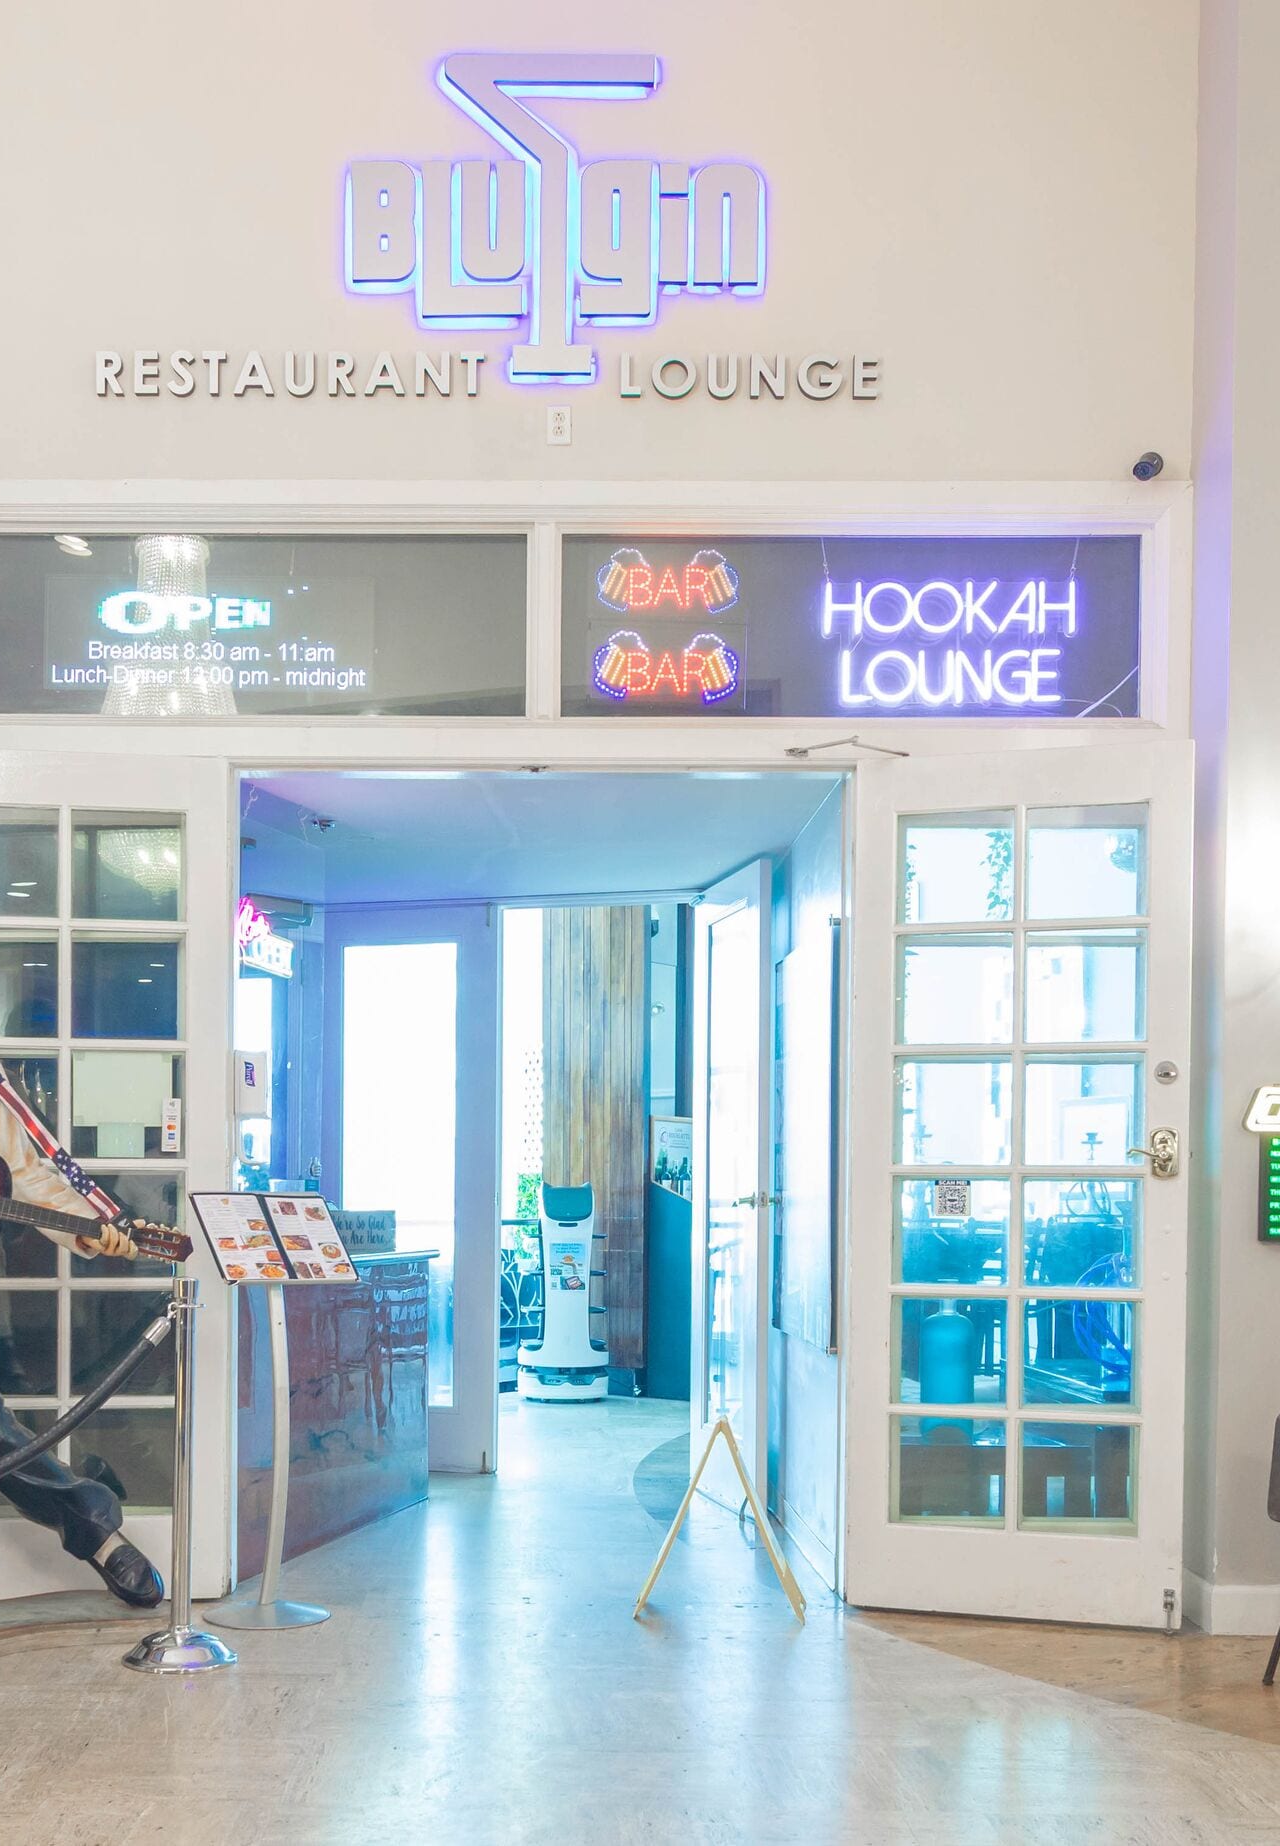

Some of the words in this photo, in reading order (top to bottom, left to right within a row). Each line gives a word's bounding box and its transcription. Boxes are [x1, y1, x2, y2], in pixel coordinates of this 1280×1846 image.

[95, 350, 486, 399] RESTAURANT
[619, 352, 881, 401] LOUNGE
[629, 567, 710, 607] BAR
[822, 579, 1077, 636] HOOKAH
[88, 640, 179, 660] Breakfast
[183, 642, 225, 661] 8:30
[229, 645, 260, 661] am
[238, 669, 269, 689] pm
[285, 668, 367, 690] midnight
[627, 651, 707, 692] BAR
[840, 648, 1062, 704] LOUNGE
